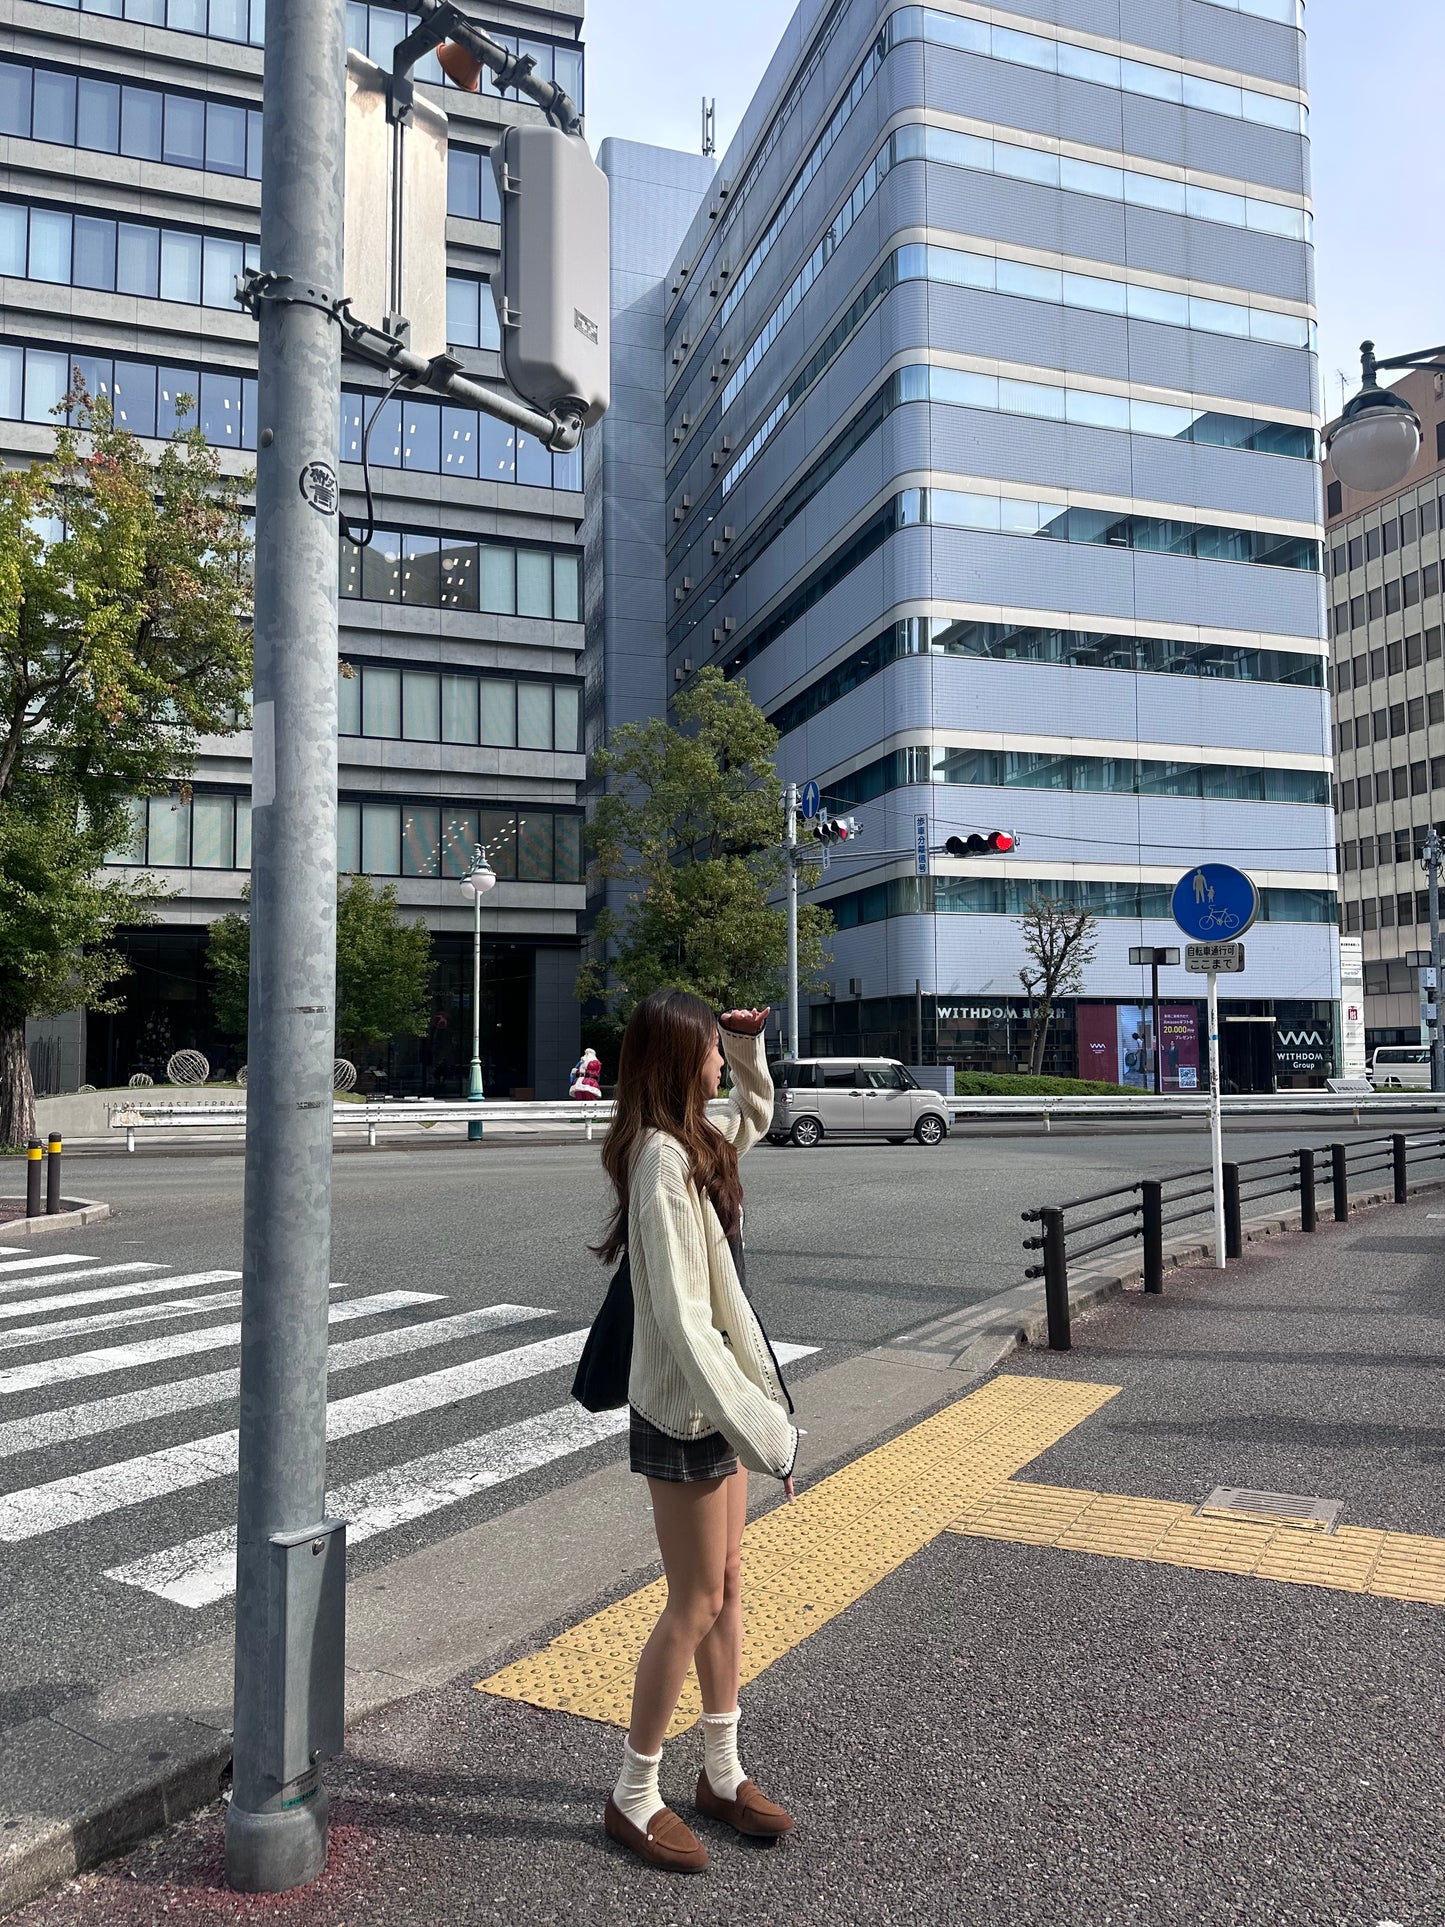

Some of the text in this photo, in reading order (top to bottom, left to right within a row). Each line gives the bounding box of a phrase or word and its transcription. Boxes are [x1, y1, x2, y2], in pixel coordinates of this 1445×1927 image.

[916, 816, 927, 873] 歩車分離信号
[1187, 945, 1235, 957] 自転車通行可
[1190, 959, 1233, 970] ここまで
[938, 1007, 1018, 1019] WITHDOM
[1276, 1052, 1323, 1060] WITHDOM
[1292, 1061, 1315, 1070] Group
